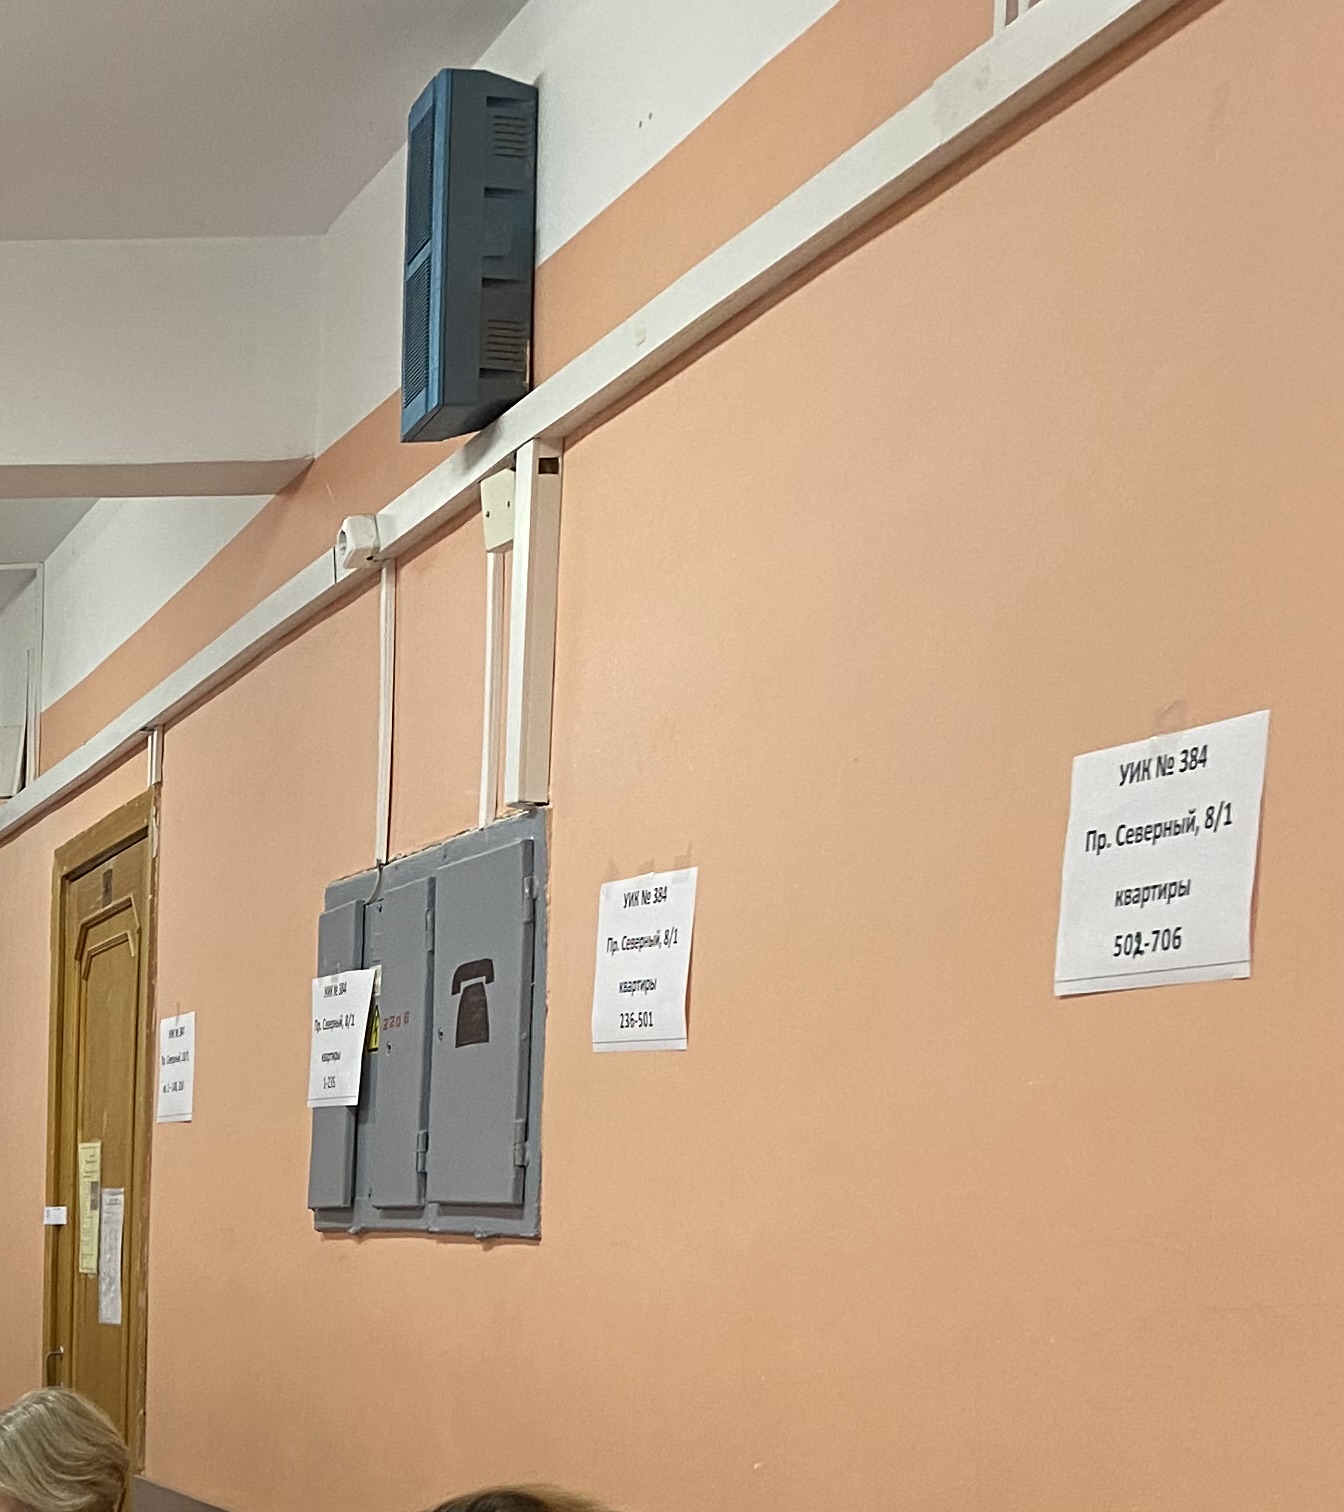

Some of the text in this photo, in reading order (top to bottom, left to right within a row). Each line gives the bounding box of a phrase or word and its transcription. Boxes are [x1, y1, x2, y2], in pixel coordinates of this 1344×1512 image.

[1119, 744, 1209, 787] УИК № 384
[1085, 801, 1233, 855] Пр. Северный, 8/1
[623, 890, 639, 908] УИК
[654, 886, 667, 904] 384
[1114, 877, 1191, 908] квартиры
[606, 927, 678, 955] Пр. Северный, 8/1
[619, 978, 657, 996] квартиры
[619, 1011, 654, 1028] 236-501
